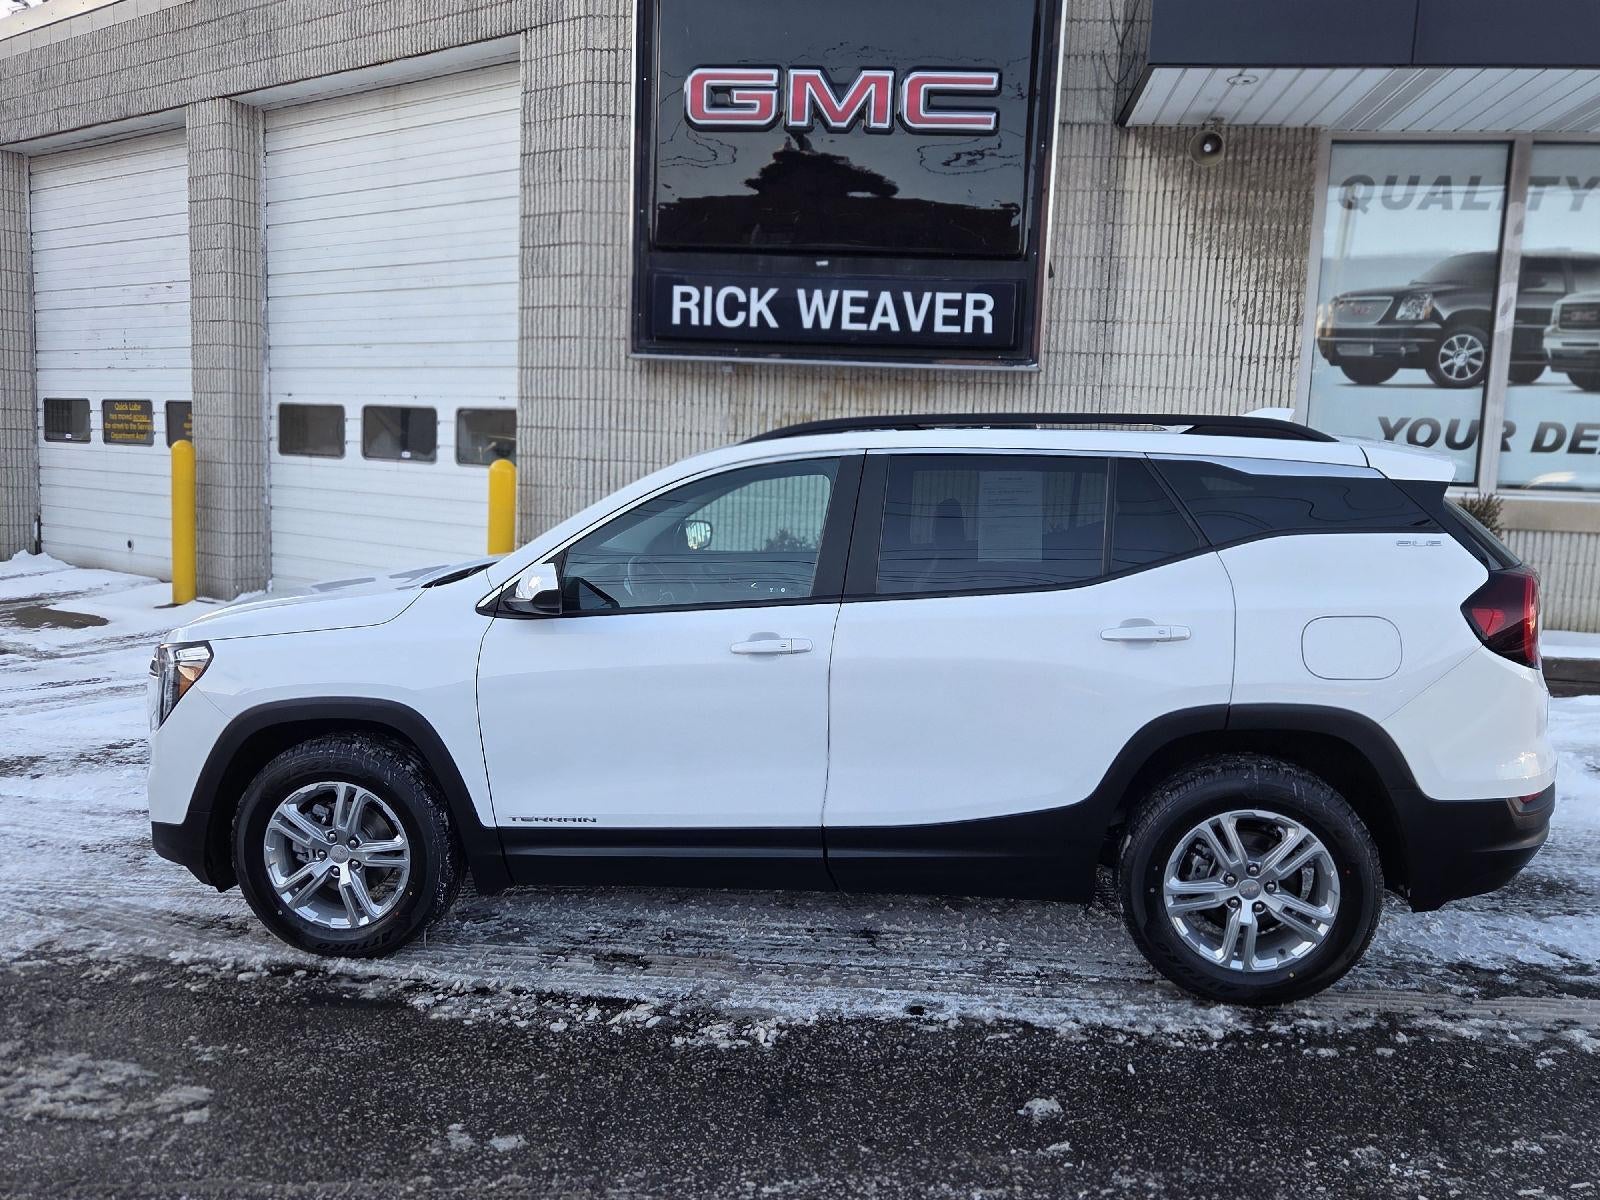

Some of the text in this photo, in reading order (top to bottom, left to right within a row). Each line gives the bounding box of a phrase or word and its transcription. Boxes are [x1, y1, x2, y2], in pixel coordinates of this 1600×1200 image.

[684, 66, 1000, 131] GMC
[1338, 174, 1600, 215] QUALTY
[671, 284, 995, 335] RICK WEAVER
[1530, 421, 1600, 454] DE
